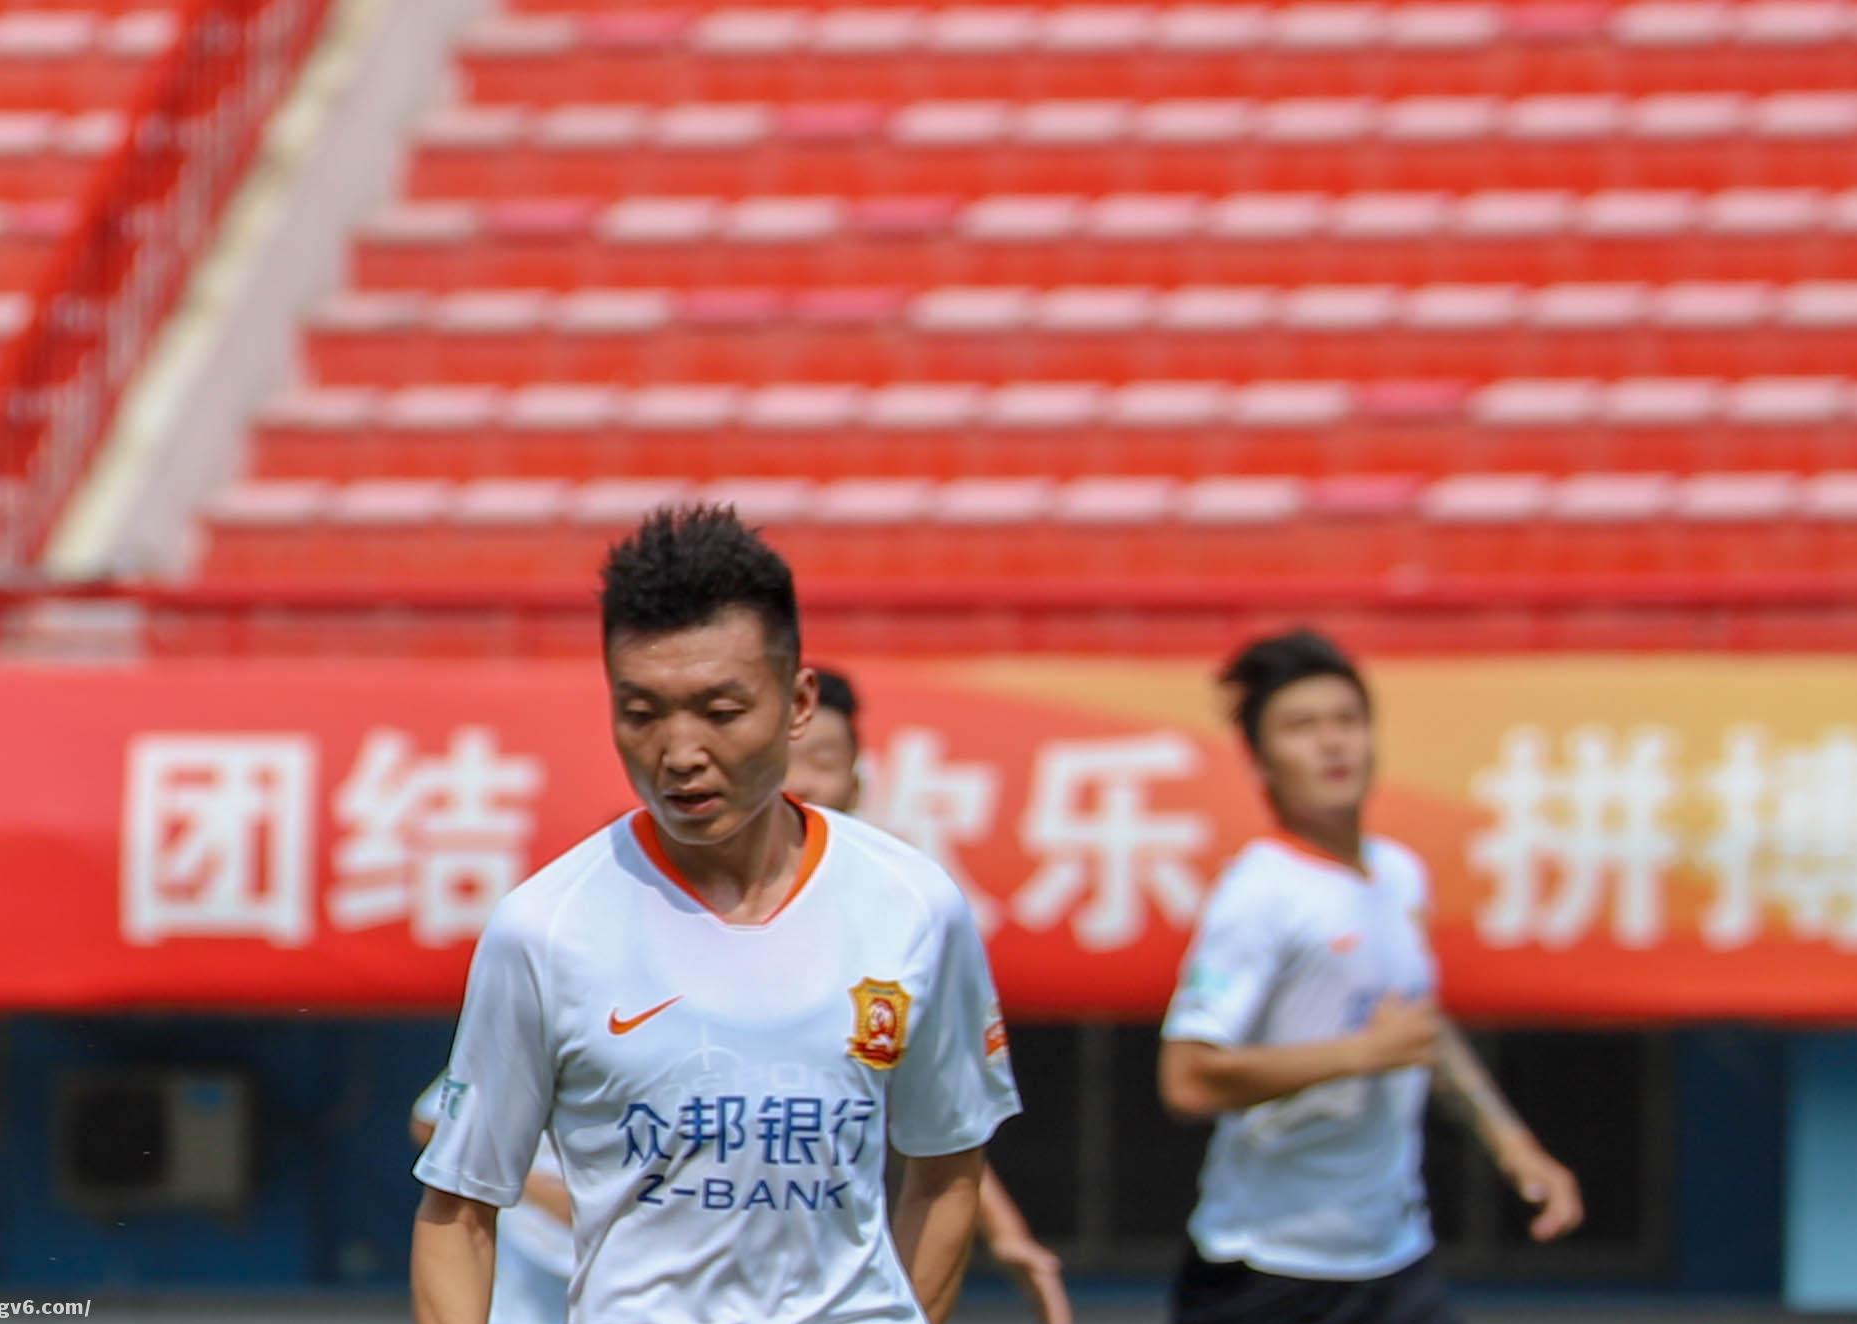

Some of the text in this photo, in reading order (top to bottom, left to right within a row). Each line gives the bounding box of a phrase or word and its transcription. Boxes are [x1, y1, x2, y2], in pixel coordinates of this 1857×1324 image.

[117, 728, 545, 948] 团结
[617, 1096, 876, 1169] 众邦银行
[637, 1173, 849, 1211] Z-BANK
